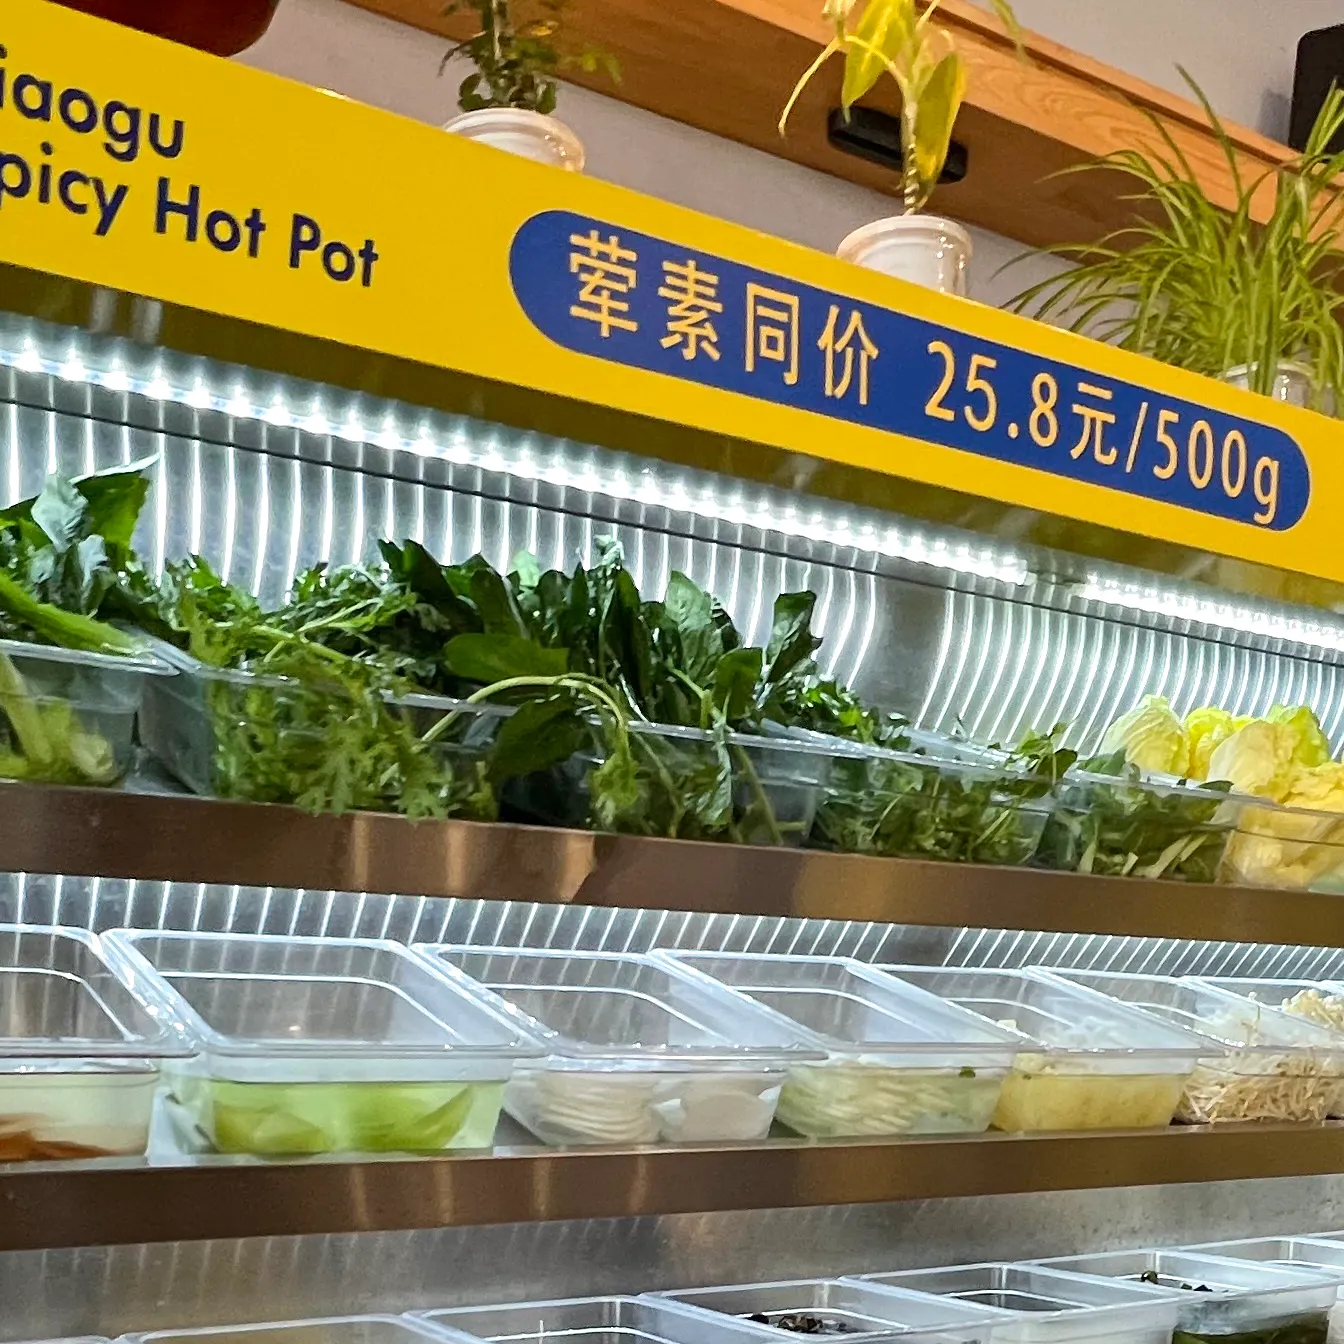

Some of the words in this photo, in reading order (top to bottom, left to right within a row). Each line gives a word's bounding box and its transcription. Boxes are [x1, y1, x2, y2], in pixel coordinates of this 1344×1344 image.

[155, 176, 266, 259] Hot
[289, 213, 379, 288] Pot
[569, 230, 879, 405] 荤素同价
[924, 340, 1280, 525] 25.8元/500g
